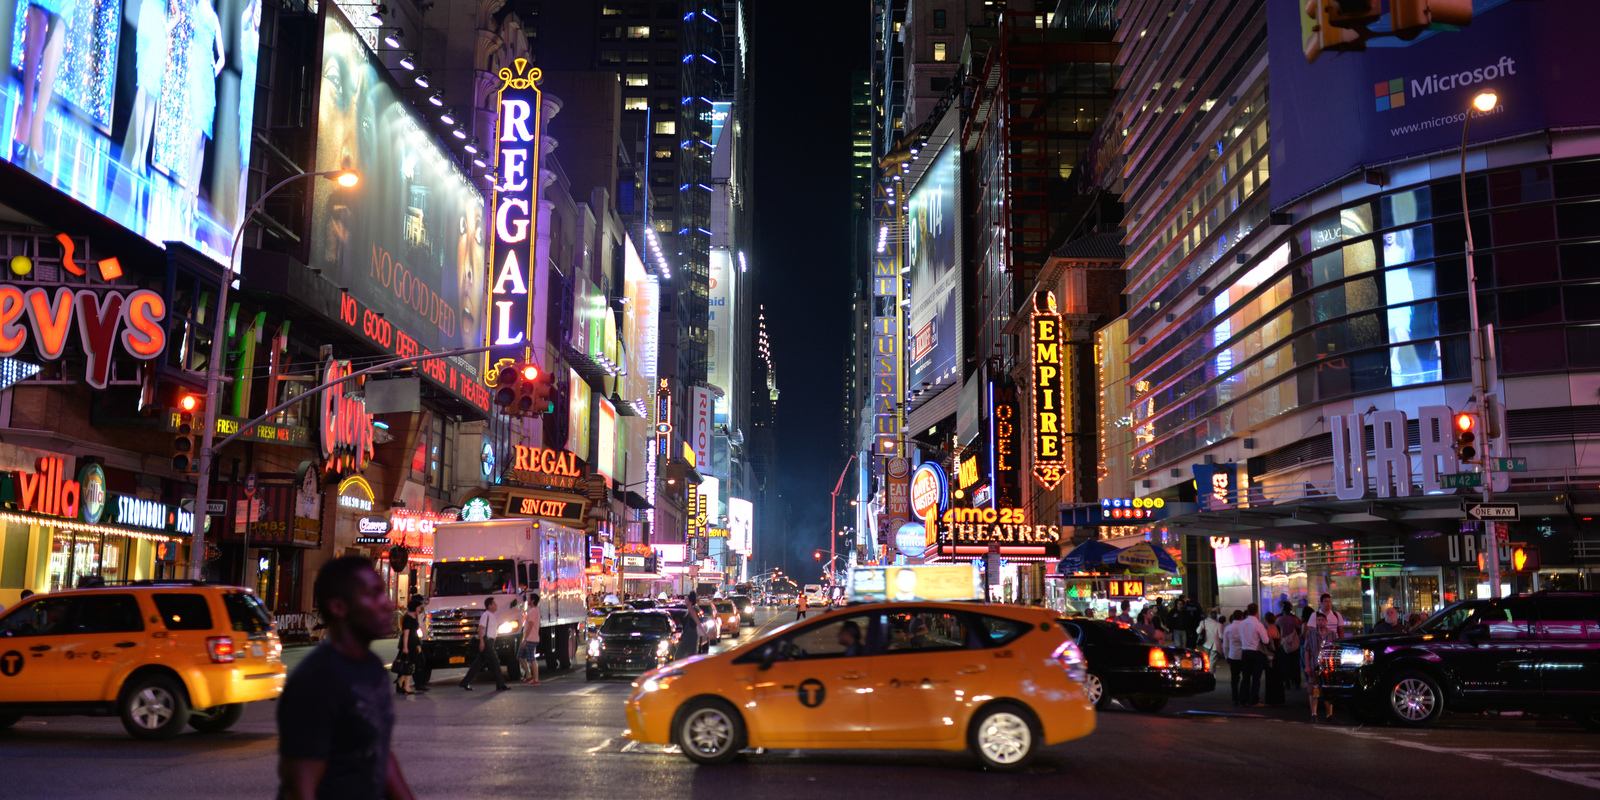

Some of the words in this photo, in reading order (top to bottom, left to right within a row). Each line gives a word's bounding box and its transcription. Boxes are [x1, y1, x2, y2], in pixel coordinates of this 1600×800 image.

[1411, 56, 1517, 98] Microsoft
[492, 99, 534, 345] REGAL
[370, 240, 393, 288] NO
[393, 262, 429, 317] GOOD
[430, 291, 456, 338] DEED
[340, 291, 358, 327] NO
[363, 308, 391, 348] GOOD
[395, 329, 418, 366] DEED
[422, 349, 446, 384] OPENS
[450, 367, 457, 391] IN
[460, 374, 491, 412] THEATERS
[878, 318, 895, 476] TUSSAUD
[1036, 320, 1059, 457] EMPIRE
[217, 419, 239, 434] FRESH
[257, 425, 276, 439] FRESH
[277, 427, 289, 441] MEX
[698, 393, 707, 467] RICOH
[514, 444, 580, 477] REGAL
[1506, 460, 1514, 470] 8
[1043, 469, 1060, 481] 25
[1459, 476, 1471, 485] 42
[19, 456, 81, 519] villa
[889, 483, 908, 496] EAT
[208, 503, 224, 512] WAY
[520, 498, 541, 514] SIN
[540, 500, 567, 517] CITY
[688, 484, 696, 515] VICTORY
[889, 503, 908, 513] PLAY
[118, 495, 166, 529] STROMBOLI
[942, 507, 997, 524] amc
[1000, 508, 1025, 524] 25
[392, 517, 415, 532] IVE
[688, 518, 696, 535] NEW
[943, 523, 1061, 543] THEATRES
[1109, 581, 1119, 596] H
[275, 614, 303, 631] HAPPY
